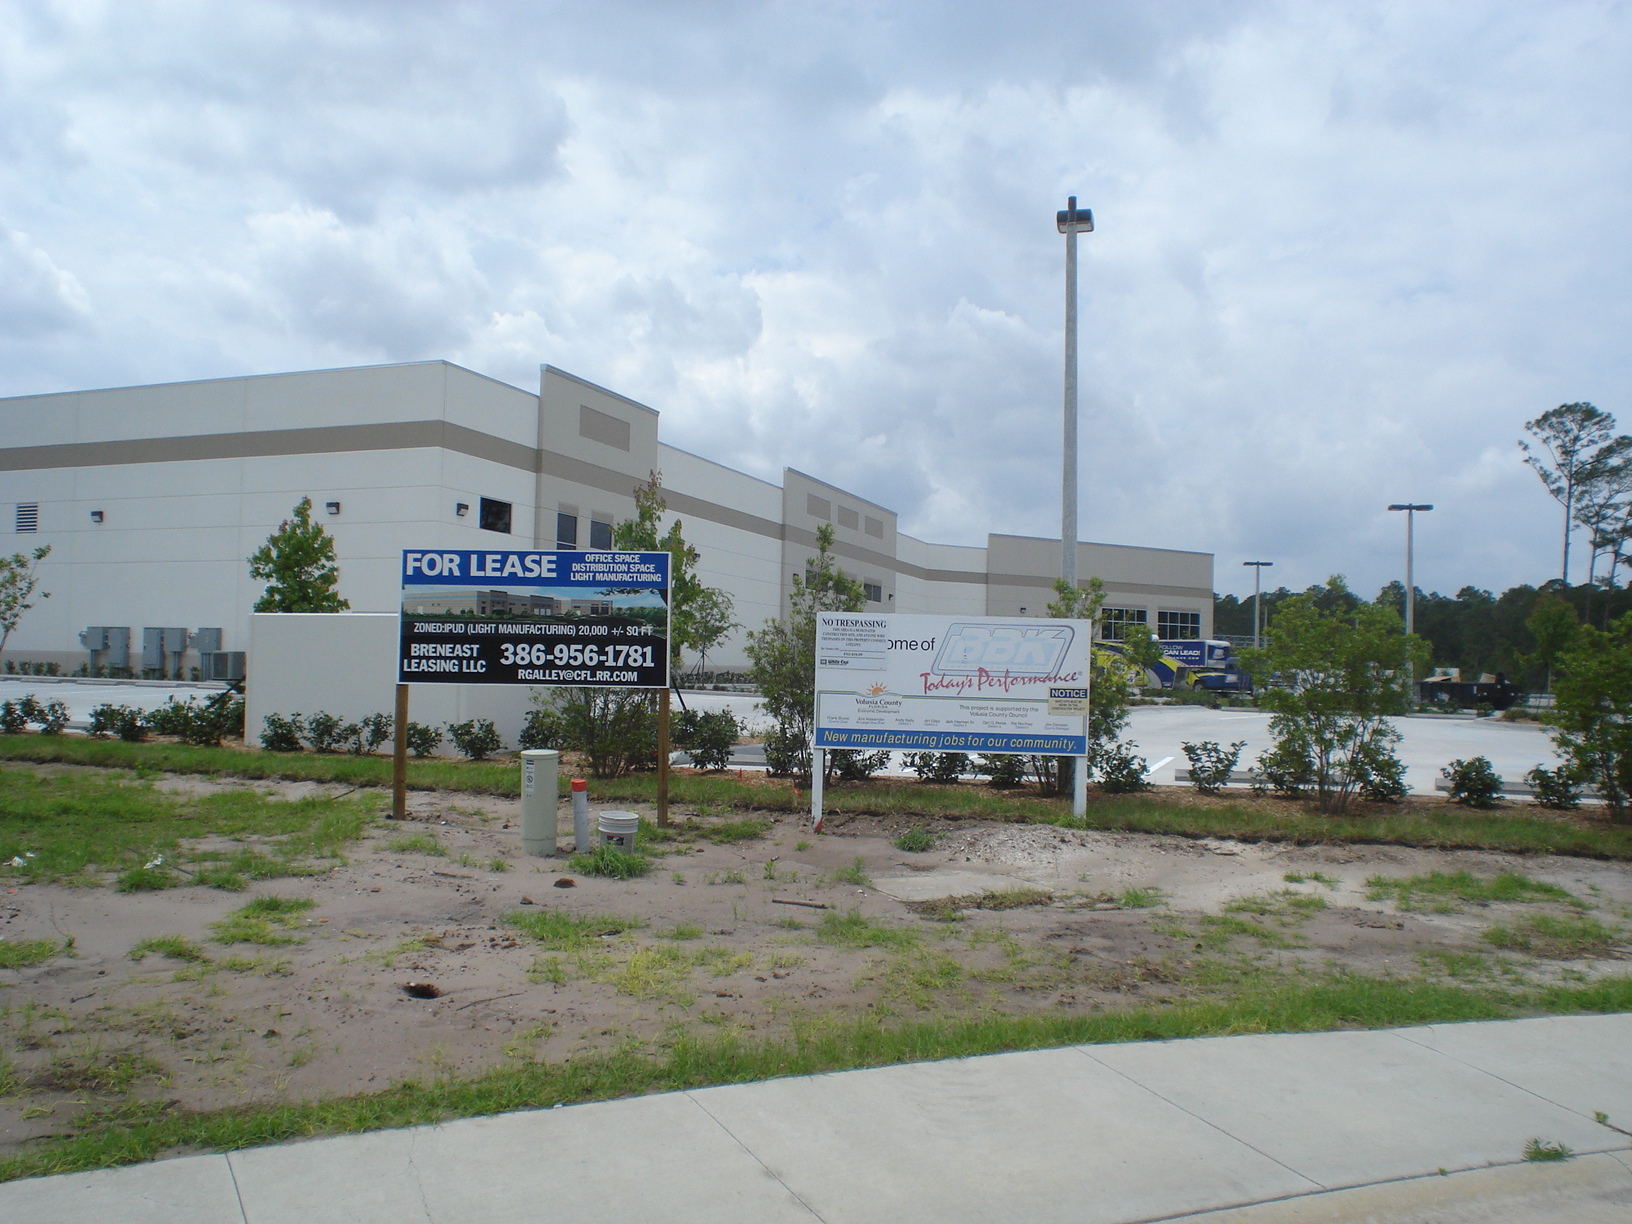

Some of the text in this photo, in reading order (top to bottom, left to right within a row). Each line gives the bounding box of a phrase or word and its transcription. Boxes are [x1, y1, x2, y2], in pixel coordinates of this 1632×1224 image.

[585, 554, 640, 563] OFFICE SPACE
[406, 553, 557, 578] FOR LEASE
[572, 563, 655, 572] DISTRIBUTION SPACE
[570, 573, 662, 582] LIGHT MANUFACTURING
[822, 618, 886, 628] NO TRESPASSING
[467, 624, 496, 635] (LIGHT
[498, 624, 576, 636] MANUFACTURING)
[579, 626, 608, 636] 20,000
[626, 626, 639, 636] SQ
[640, 627, 653, 636] FT
[411, 644, 479, 657] BRENEAST
[888, 637, 935, 651] ome of
[946, 627, 1065, 666] BBK
[499, 643, 655, 668] 386-956-1781
[403, 659, 486, 673] LEASING LLC
[518, 670, 637, 682] RGALLEY@CFL.RR.COM
[920, 667, 1078, 695] Today's Performance
[879, 699, 902, 707] County
[823, 731, 1077, 750] New manufacturing jobs for our community.
